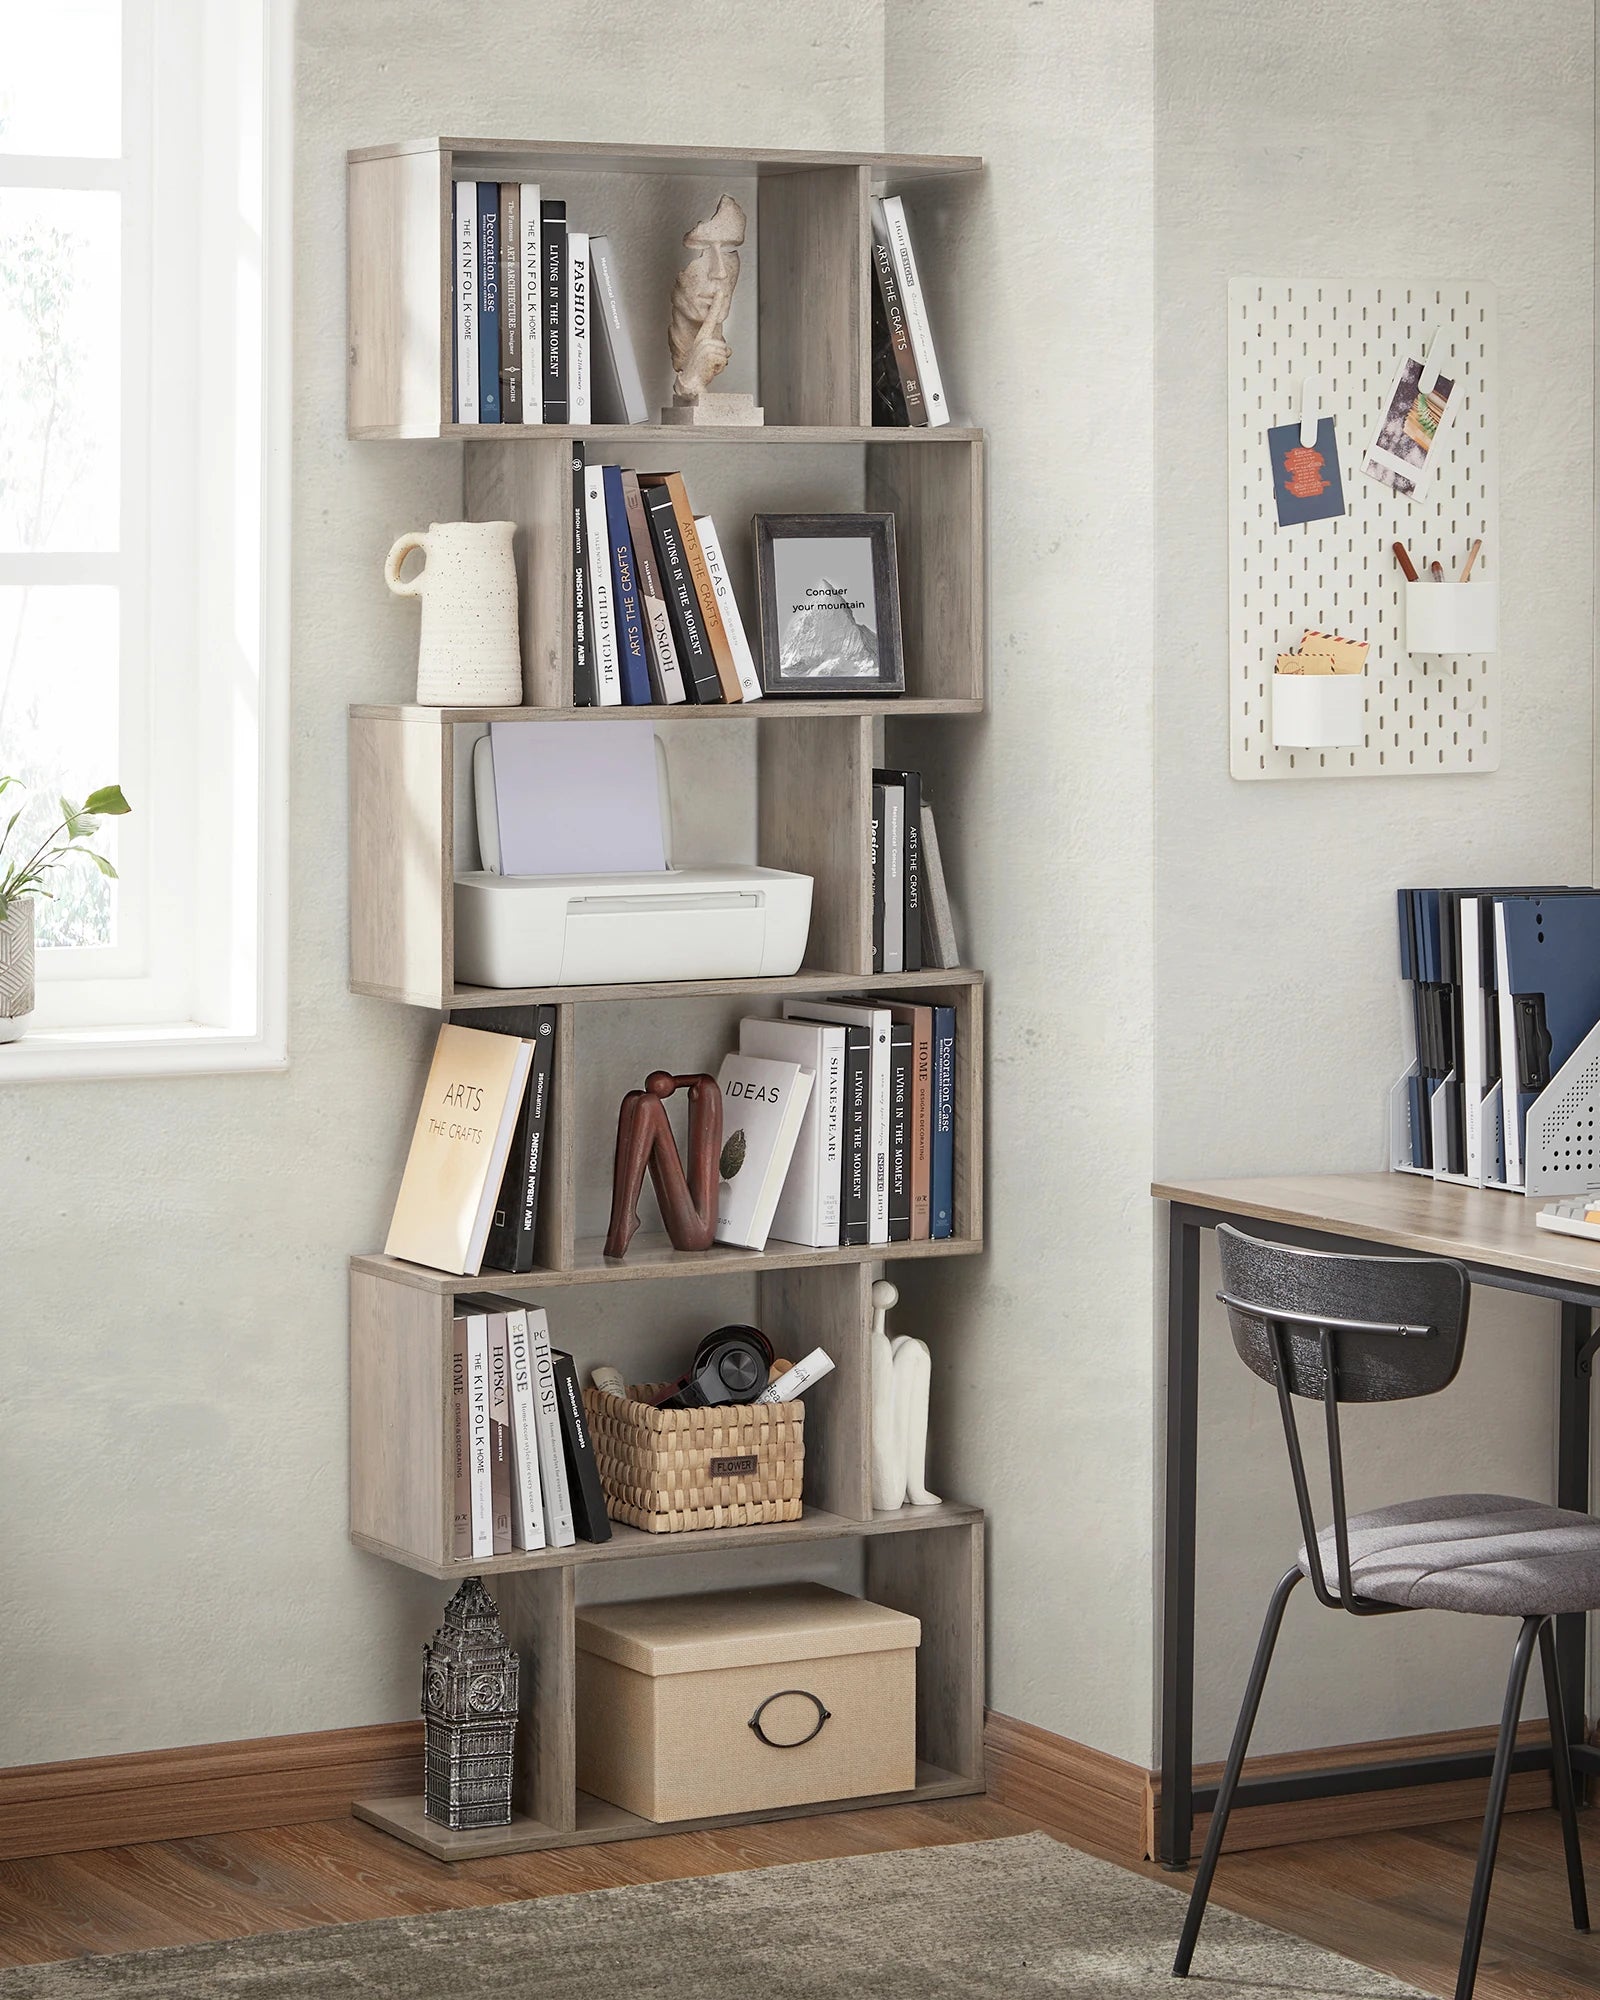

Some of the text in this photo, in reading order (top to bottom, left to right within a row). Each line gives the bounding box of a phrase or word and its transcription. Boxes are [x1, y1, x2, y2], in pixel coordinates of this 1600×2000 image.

[463, 242, 472, 312] KINFOLK
[487, 214, 497, 312] Decoration Case
[528, 242, 536, 312] KINFOLK
[900, 248, 914, 287] DESIGNS
[550, 245, 559, 377] LIVING IN THE MOMENT
[574, 259, 584, 339] FASHION
[600, 257, 620, 329] Metaphorical Concepts
[876, 244, 907, 350] ARTS THE CRAFTS
[664, 528, 702, 655] LIVING IN THE MOMENT
[683, 522, 718, 628] ARTS THE CRAFTS
[705, 545, 726, 597] IDEAS
[805, 588, 848, 597] Conquer
[617, 546, 641, 656] ARTS THE CRAFTS
[792, 601, 865, 613] your mountain
[598, 586, 613, 684] TRICIA GUILD
[654, 613, 674, 672] HOPSCA
[855, 1070, 863, 1106] LIVING
[896, 1068, 904, 1102] LIVING
[920, 1042, 928, 1081] HOME
[942, 1038, 952, 1132] Decoration Case
[442, 1082, 484, 1112] ARTS
[725, 1080, 780, 1104] IDEAS
[828, 1058, 838, 1162] SHAKESPEARE
[855, 1112, 862, 1122] IN
[896, 1108, 903, 1118] IN
[429, 1118, 483, 1144] THE CRAFTS
[529, 1133, 539, 1172] HOUSING
[526, 1176, 535, 1206] URBAN
[454, 1353, 463, 1395] HOME
[493, 1346, 504, 1406] HOPSCA
[513, 1334, 528, 1392] HOUSE
[536, 1345, 556, 1415] HOUSE
[474, 1375, 485, 1446] KINFOLK
[566, 1377, 586, 1448] Metaphorical Concepts
[717, 1461, 752, 1473] FLOWER
